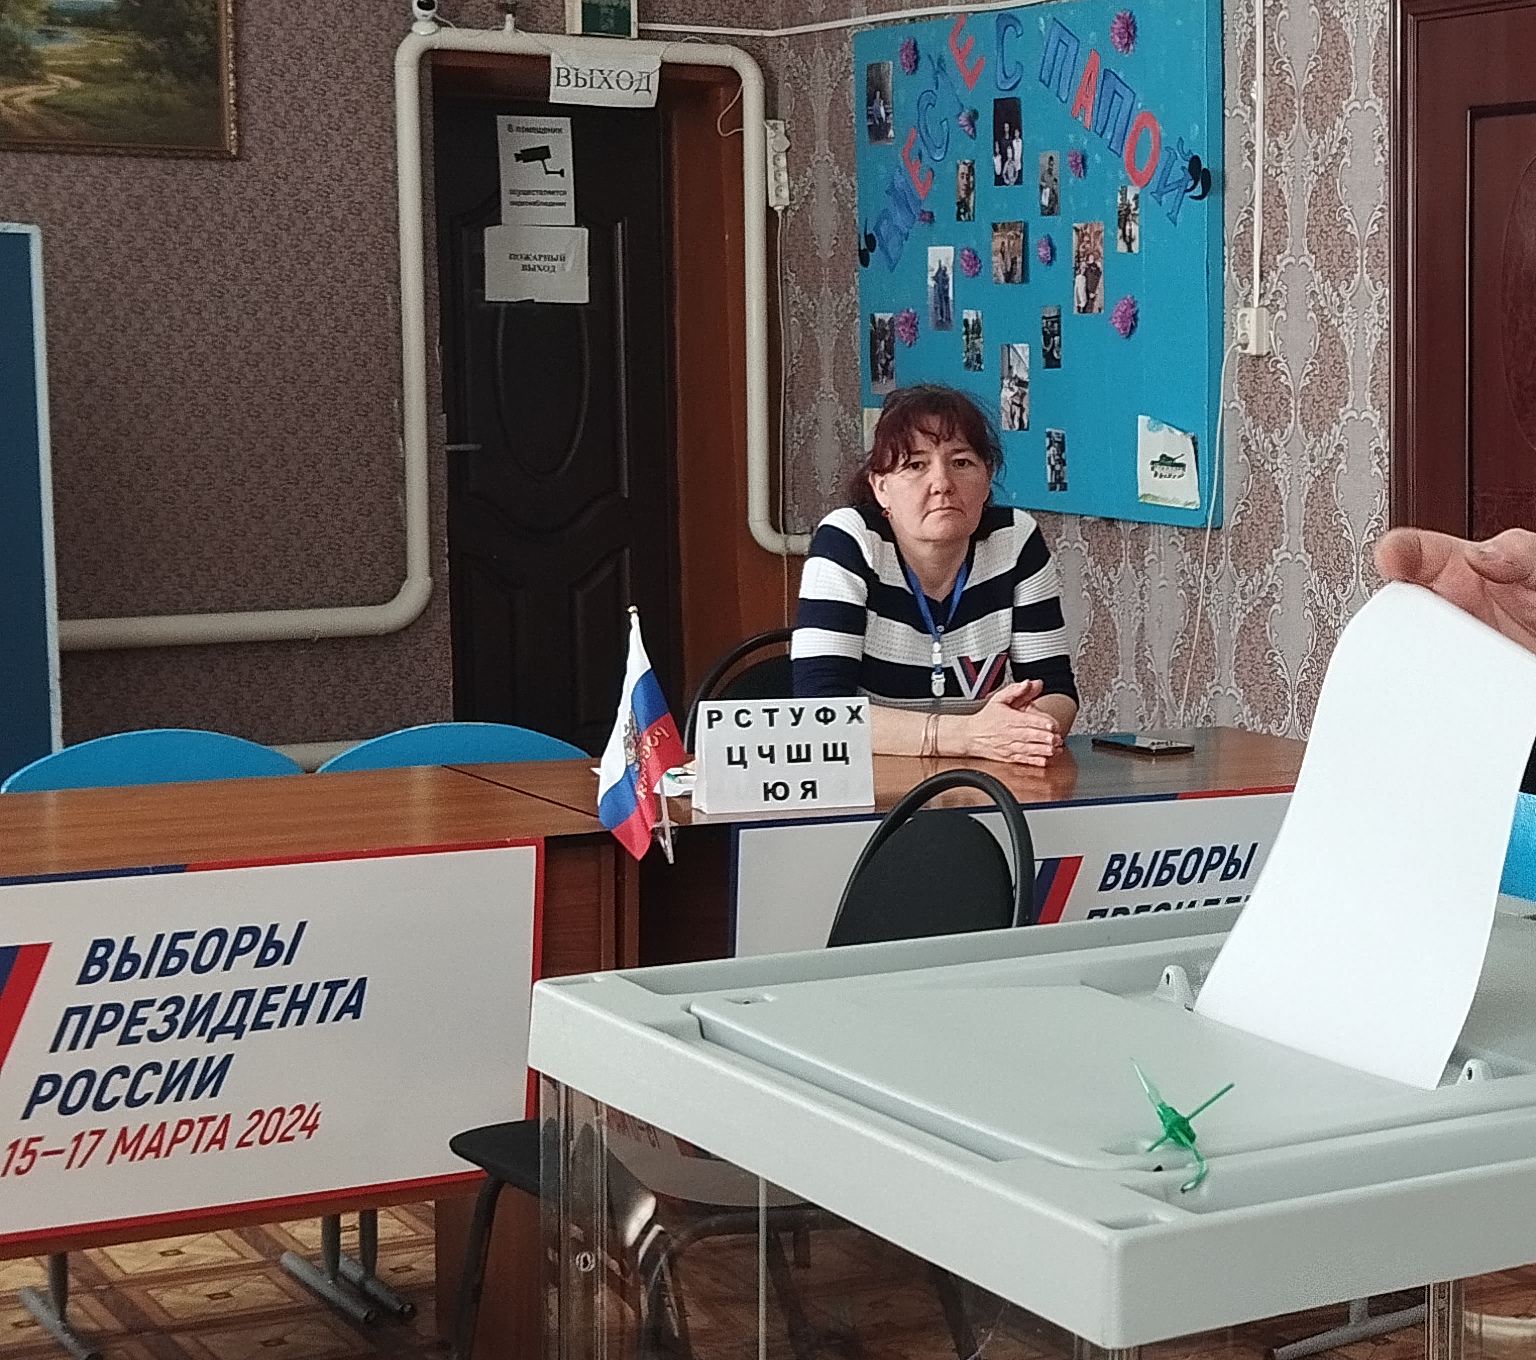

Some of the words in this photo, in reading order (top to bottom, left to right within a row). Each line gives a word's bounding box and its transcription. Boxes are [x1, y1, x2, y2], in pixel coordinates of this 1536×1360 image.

[555, 66, 652, 95] ВЫХОД
[995, 11, 1024, 92] С
[1098, 842, 1258, 892] ВЫБОРЫ
[76, 920, 308, 986] ВЫБОРЫ
[49, 976, 369, 1053] ПРЕЗИДЕНТА
[21, 1054, 234, 1120] РОССИИ
[107, 1113, 231, 1165] МАРТА
[236, 1102, 321, 1149] 2024
